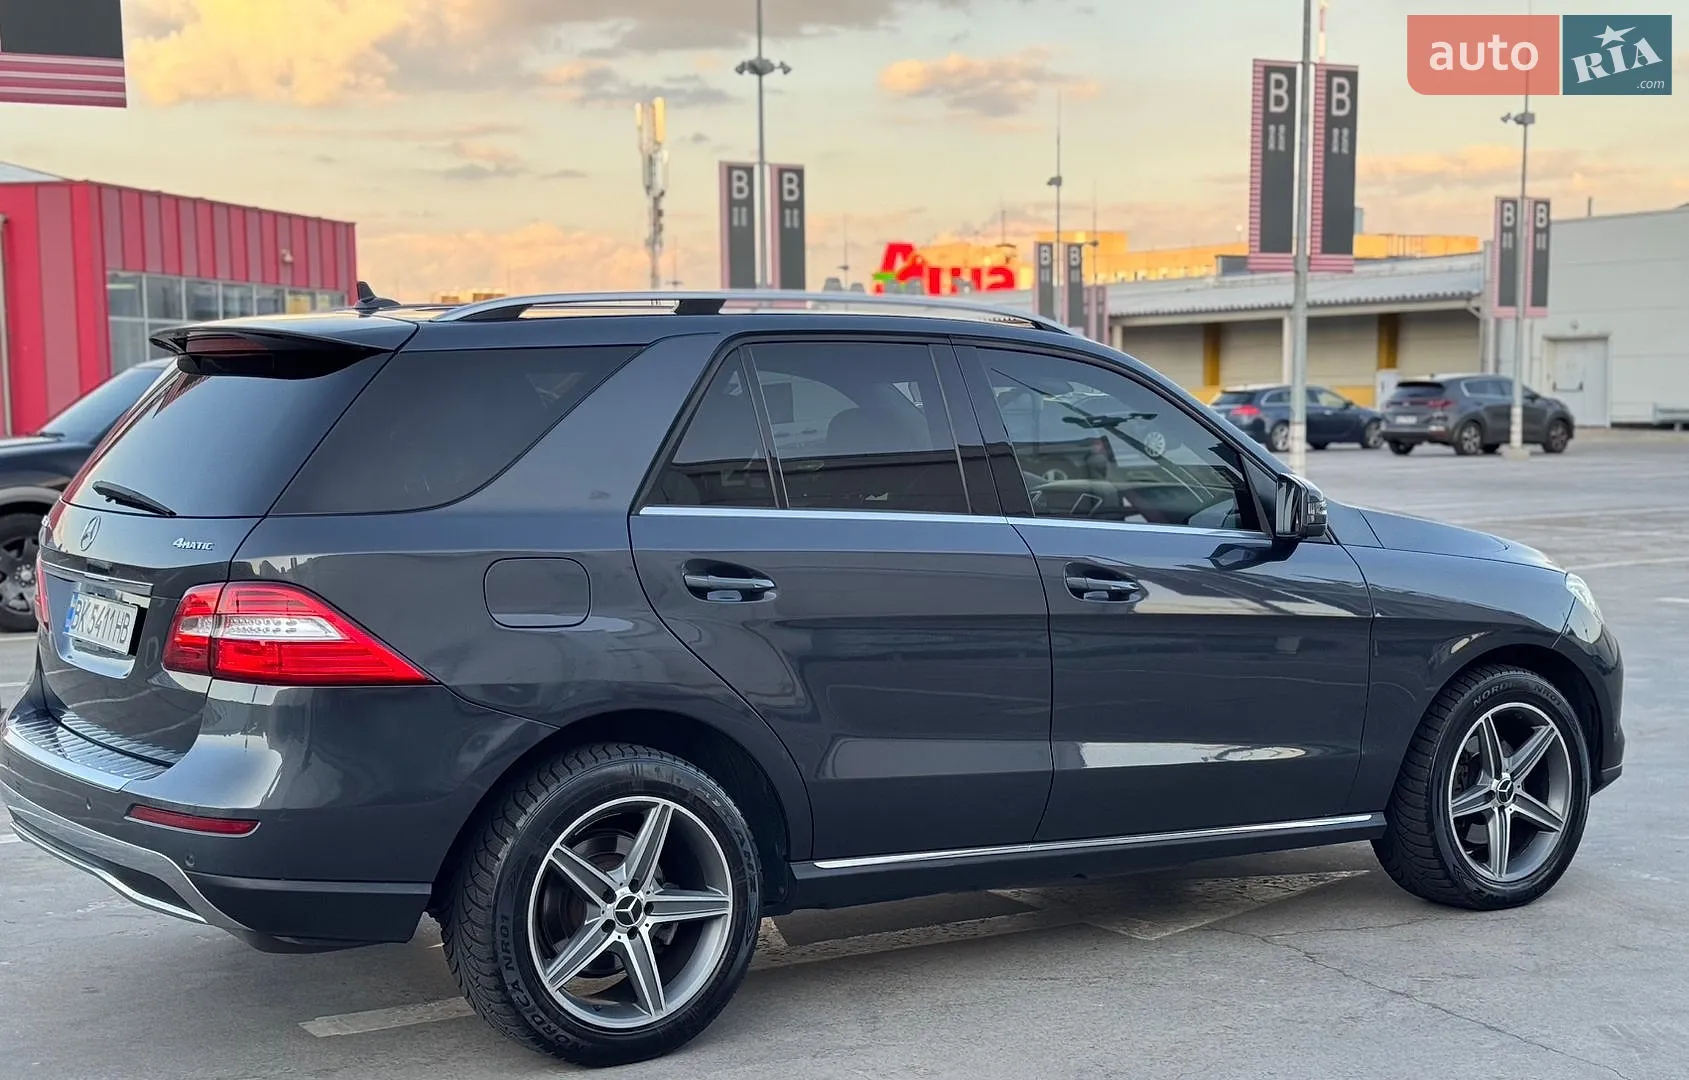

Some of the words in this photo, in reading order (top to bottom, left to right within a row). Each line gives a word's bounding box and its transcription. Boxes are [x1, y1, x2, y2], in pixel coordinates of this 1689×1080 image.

[1269, 72, 1289, 113] B
[1331, 76, 1351, 116] B
[732, 169, 749, 200] B
[783, 171, 800, 202] B
[1503, 202, 1515, 227] B
[1535, 203, 1548, 228] B
[172, 537, 216, 550] 4MATIC
[87, 604, 115, 641] 5411
